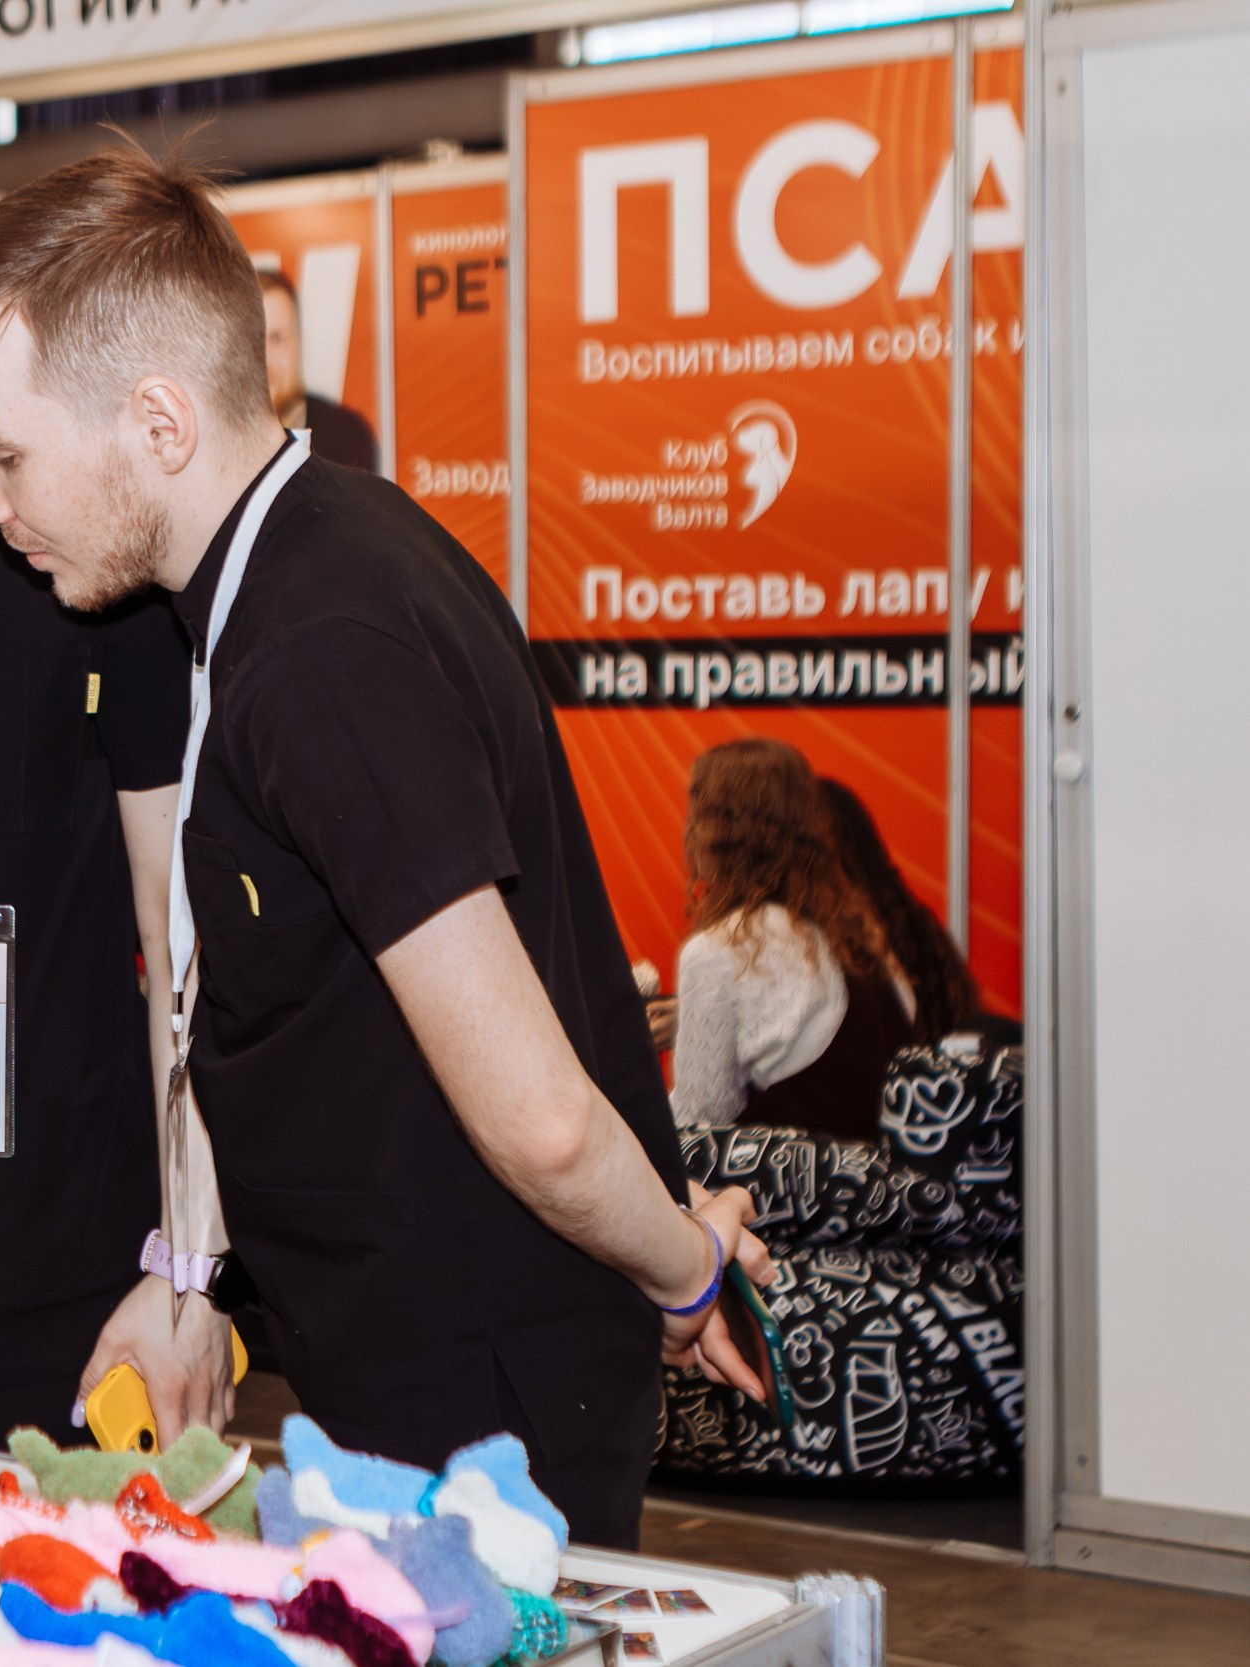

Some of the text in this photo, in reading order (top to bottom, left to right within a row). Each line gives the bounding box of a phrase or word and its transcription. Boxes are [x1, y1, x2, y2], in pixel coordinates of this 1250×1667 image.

[581, 334, 854, 382] Воспитываем
[665, 437, 729, 473] Клуб
[582, 471, 729, 504] Заводчиков
[653, 501, 729, 532] Валта
[583, 566, 828, 621] Поставь
[584, 651, 649, 698] на
